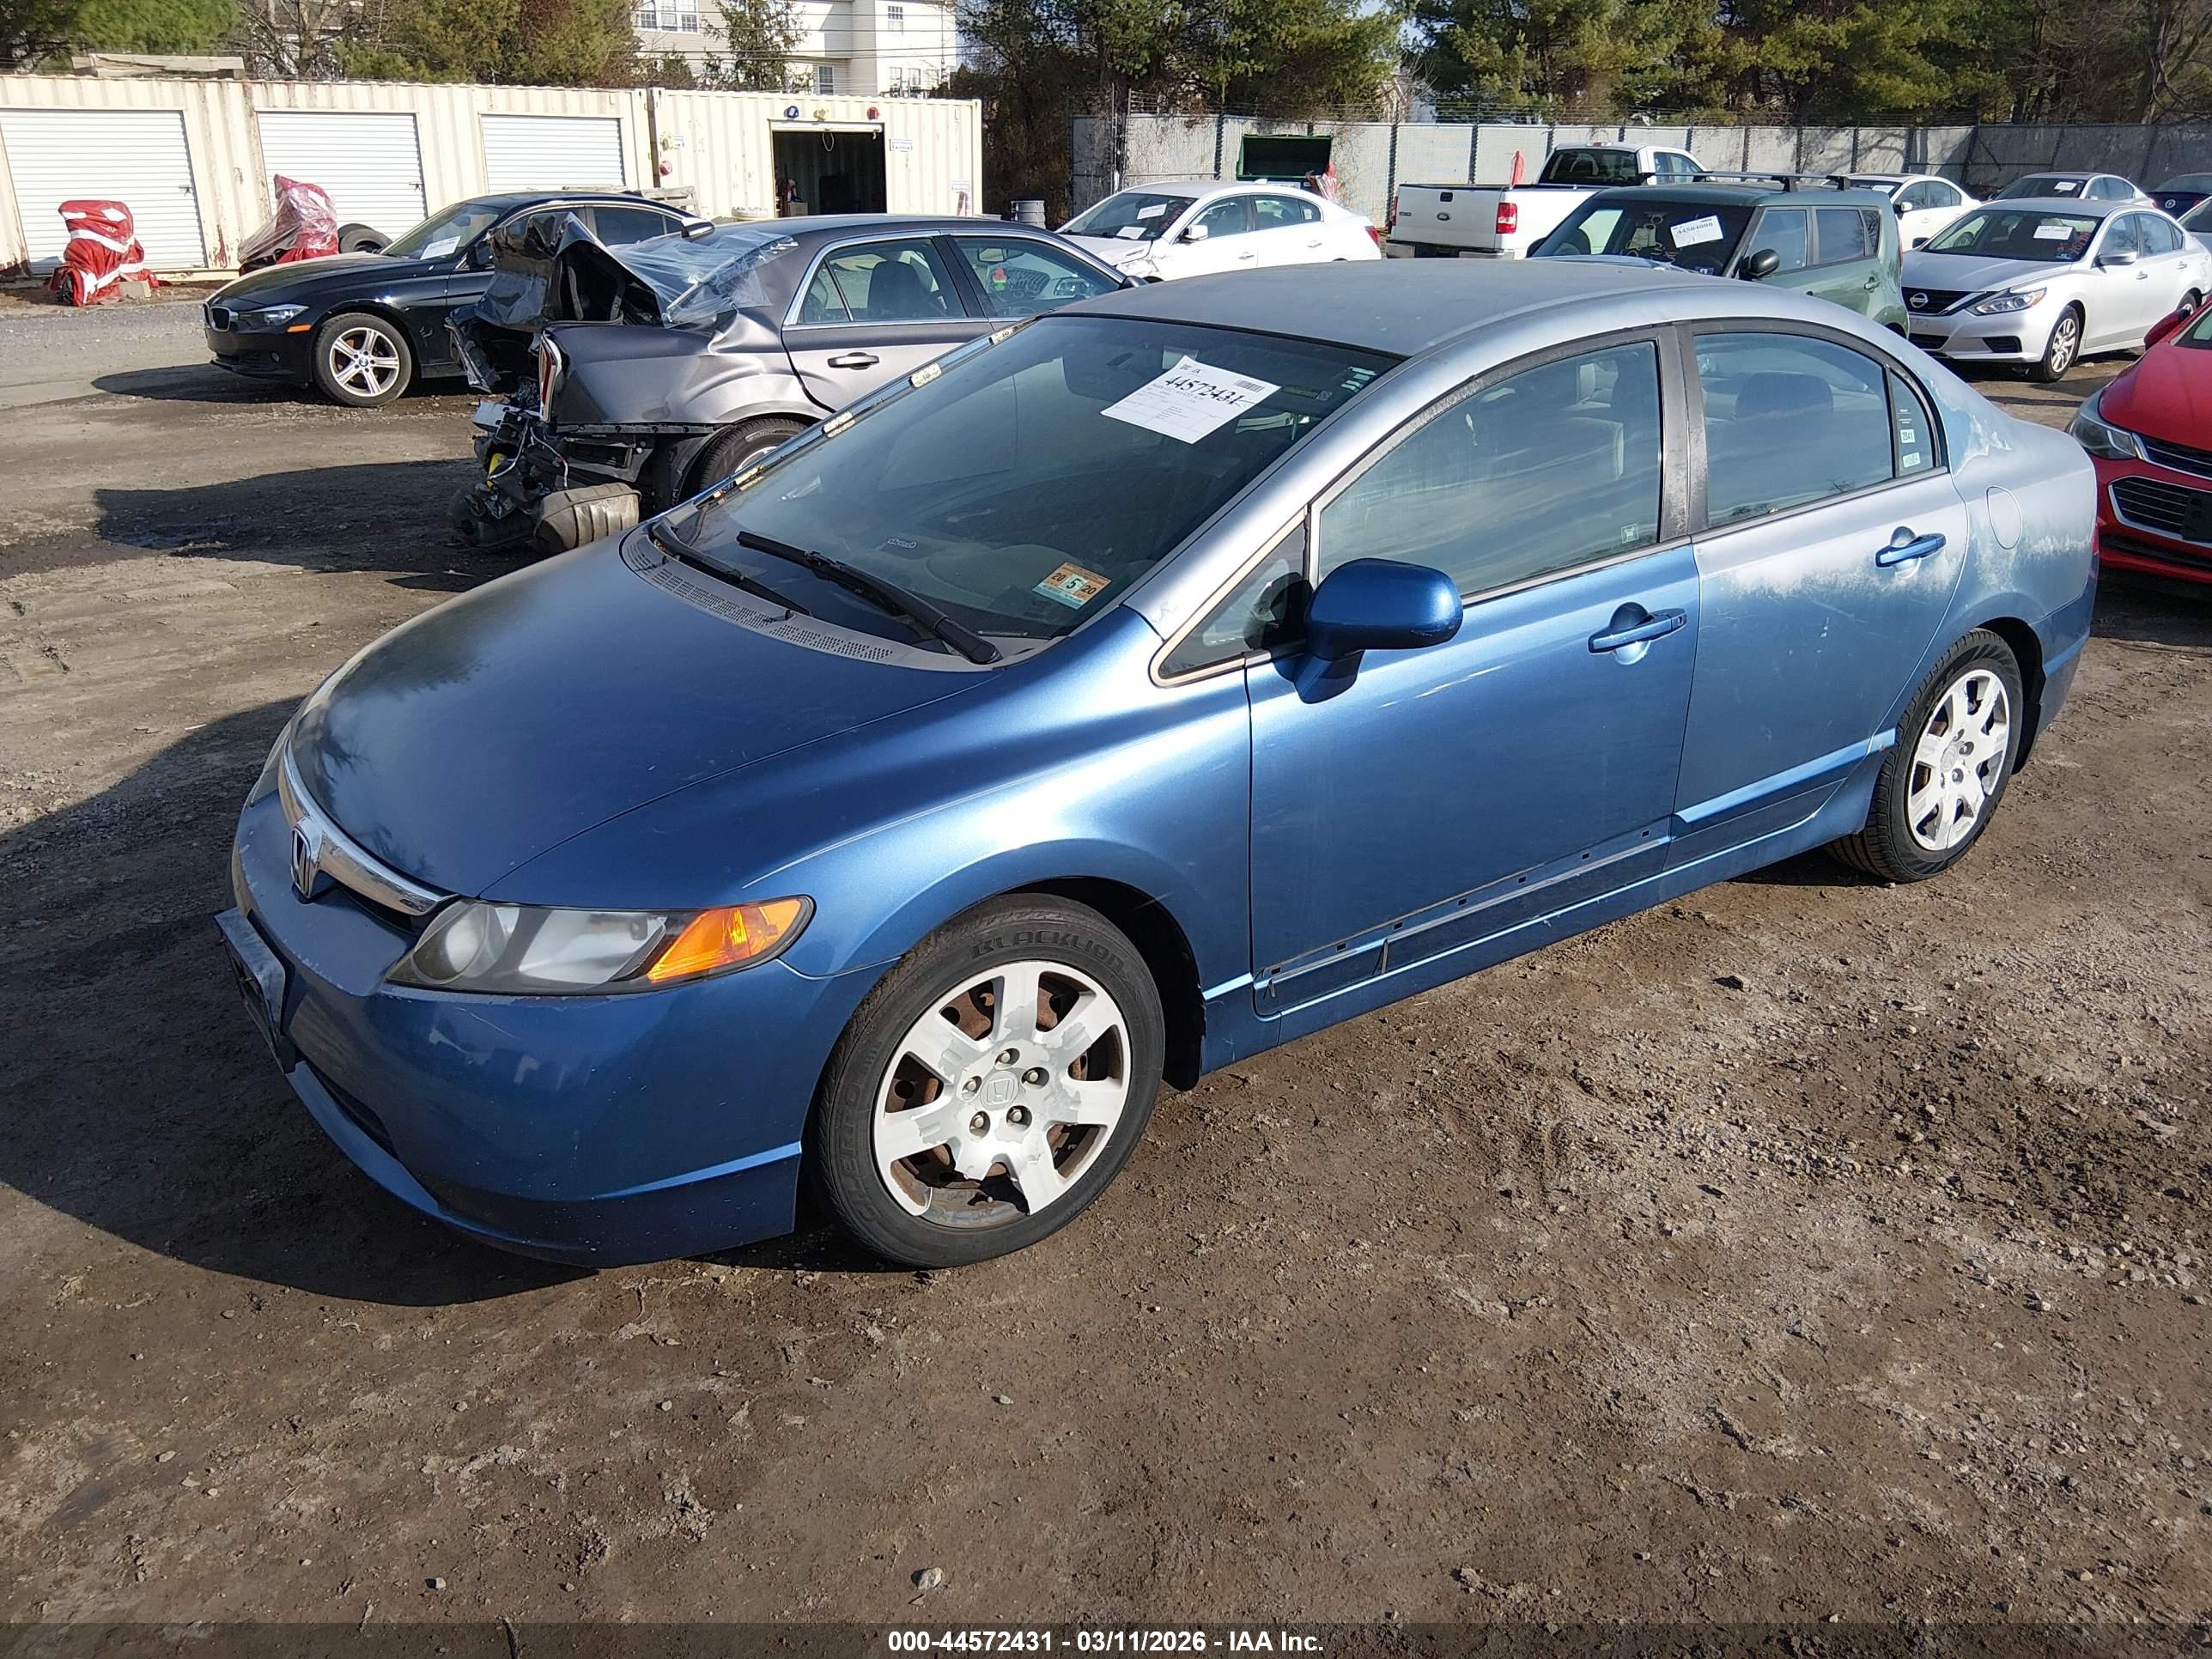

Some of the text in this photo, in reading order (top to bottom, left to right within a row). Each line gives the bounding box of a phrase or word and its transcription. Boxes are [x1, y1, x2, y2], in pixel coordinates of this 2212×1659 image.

[1164, 375, 1245, 404] 44572431
[1051, 572, 1097, 595] 20 5 20
[970, 929, 1125, 974] BLACKLION
